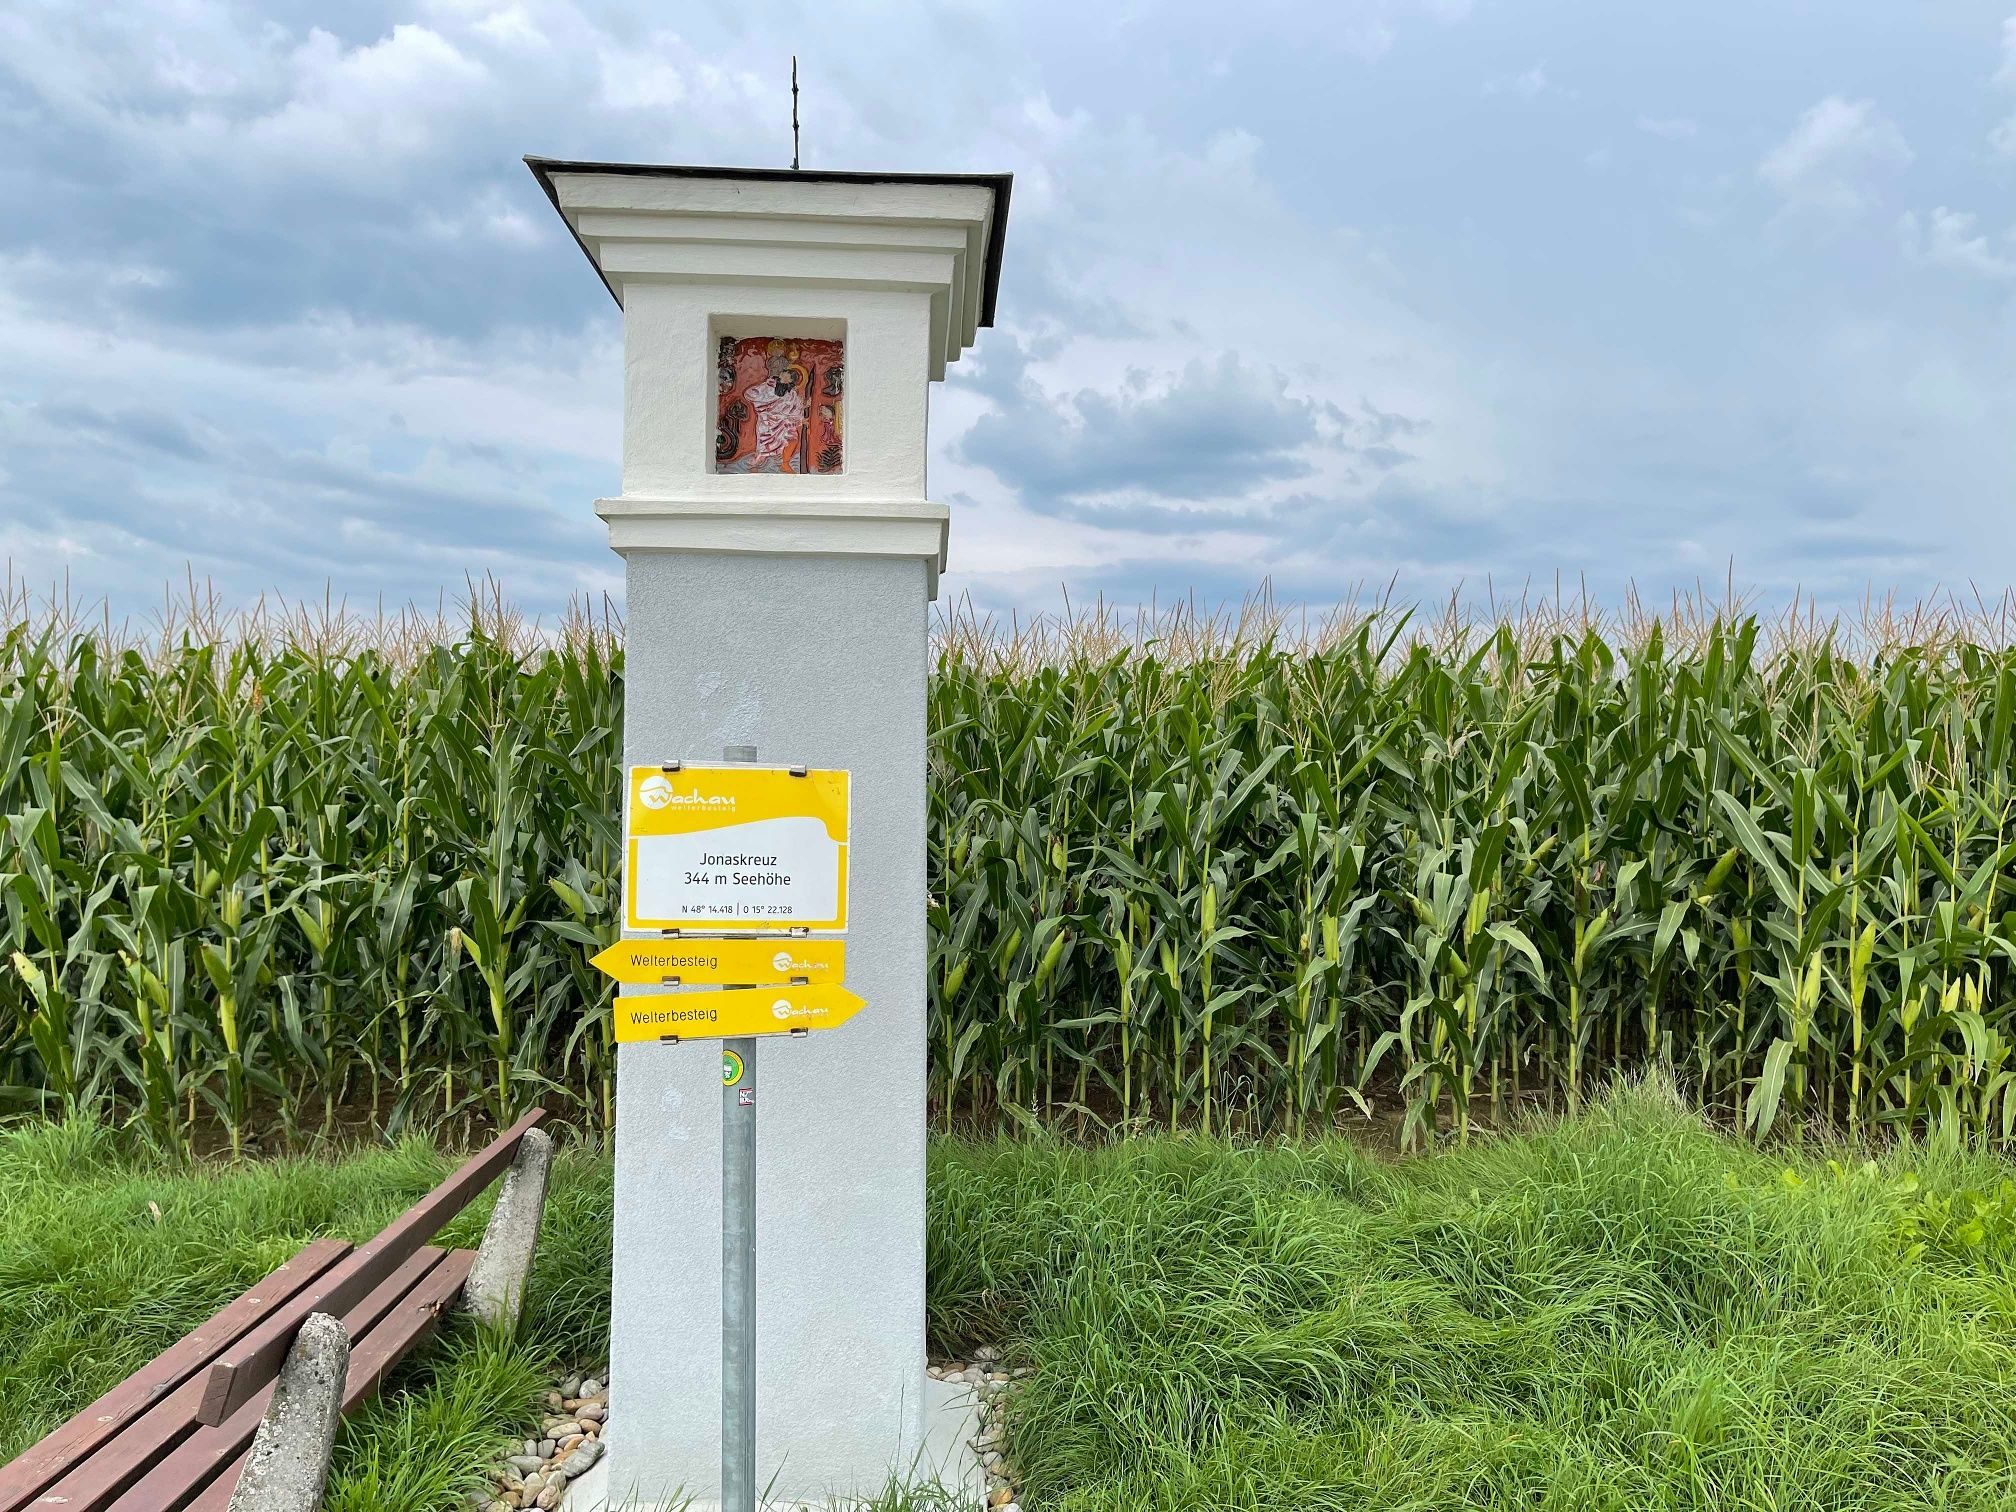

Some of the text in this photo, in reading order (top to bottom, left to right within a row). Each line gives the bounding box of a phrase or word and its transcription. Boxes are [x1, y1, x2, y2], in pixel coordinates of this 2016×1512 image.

[645, 782, 736, 806] Wachau
[699, 852, 778, 866] Jonaskreuz
[684, 871, 791, 886] 344 m Seehöhe
[681, 905, 688, 914] N
[708, 905, 734, 914] 14.418
[767, 905, 793, 914] 22.128
[630, 954, 718, 970] Welterbesteig
[630, 1007, 718, 1025] Welterbesteig
